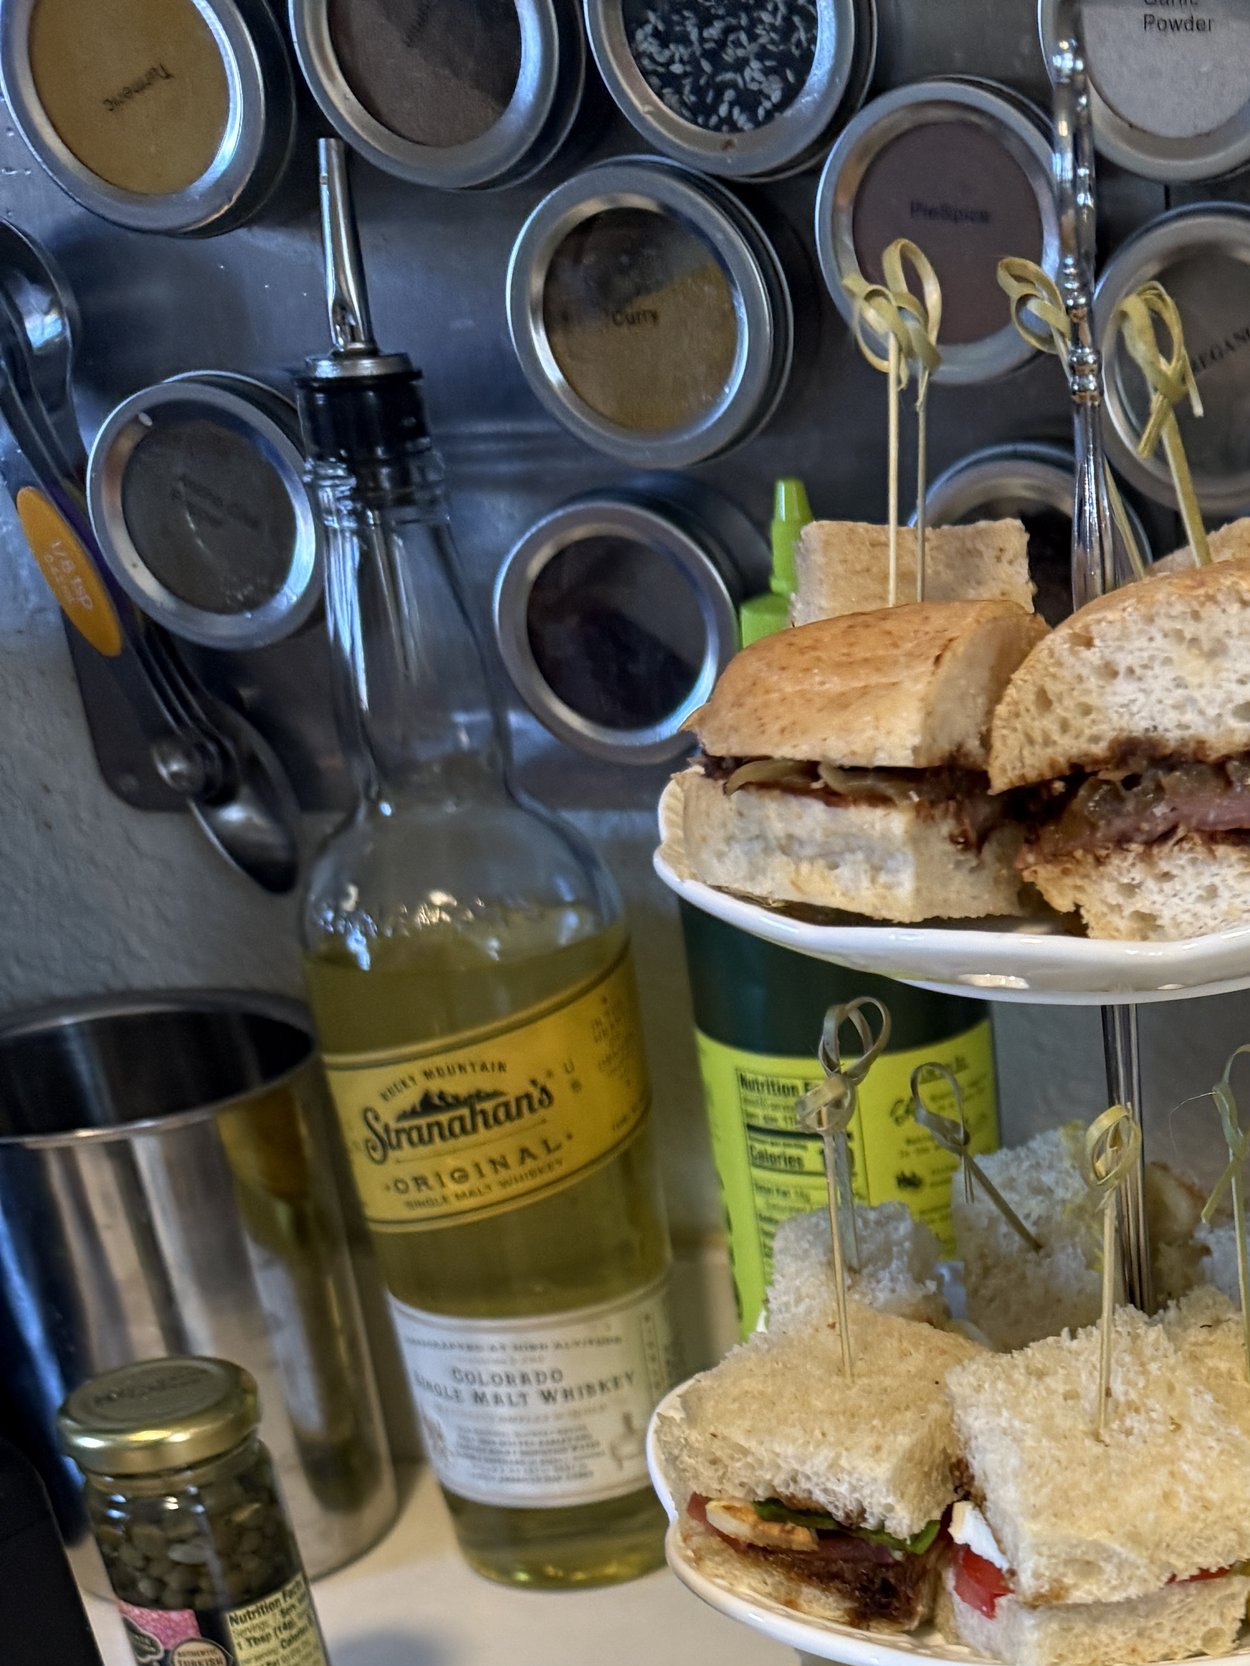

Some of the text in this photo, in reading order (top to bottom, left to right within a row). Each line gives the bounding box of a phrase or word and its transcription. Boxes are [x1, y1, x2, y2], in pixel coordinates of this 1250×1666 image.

[1143, 13, 1214, 33] Powder
[611, 307, 660, 328] Curry
[423, 1060, 508, 1081] MOUNTAIN
[740, 1072, 800, 1097] Nutrition
[364, 1077, 555, 1165] Stranahan's
[393, 1137, 562, 1195] ORIGINAL
[451, 1365, 565, 1388] COLORADO
[472, 1389, 530, 1408] MALT
[540, 1370, 637, 1405] WHISKEY
[229, 1596, 282, 1628] Nutrition
